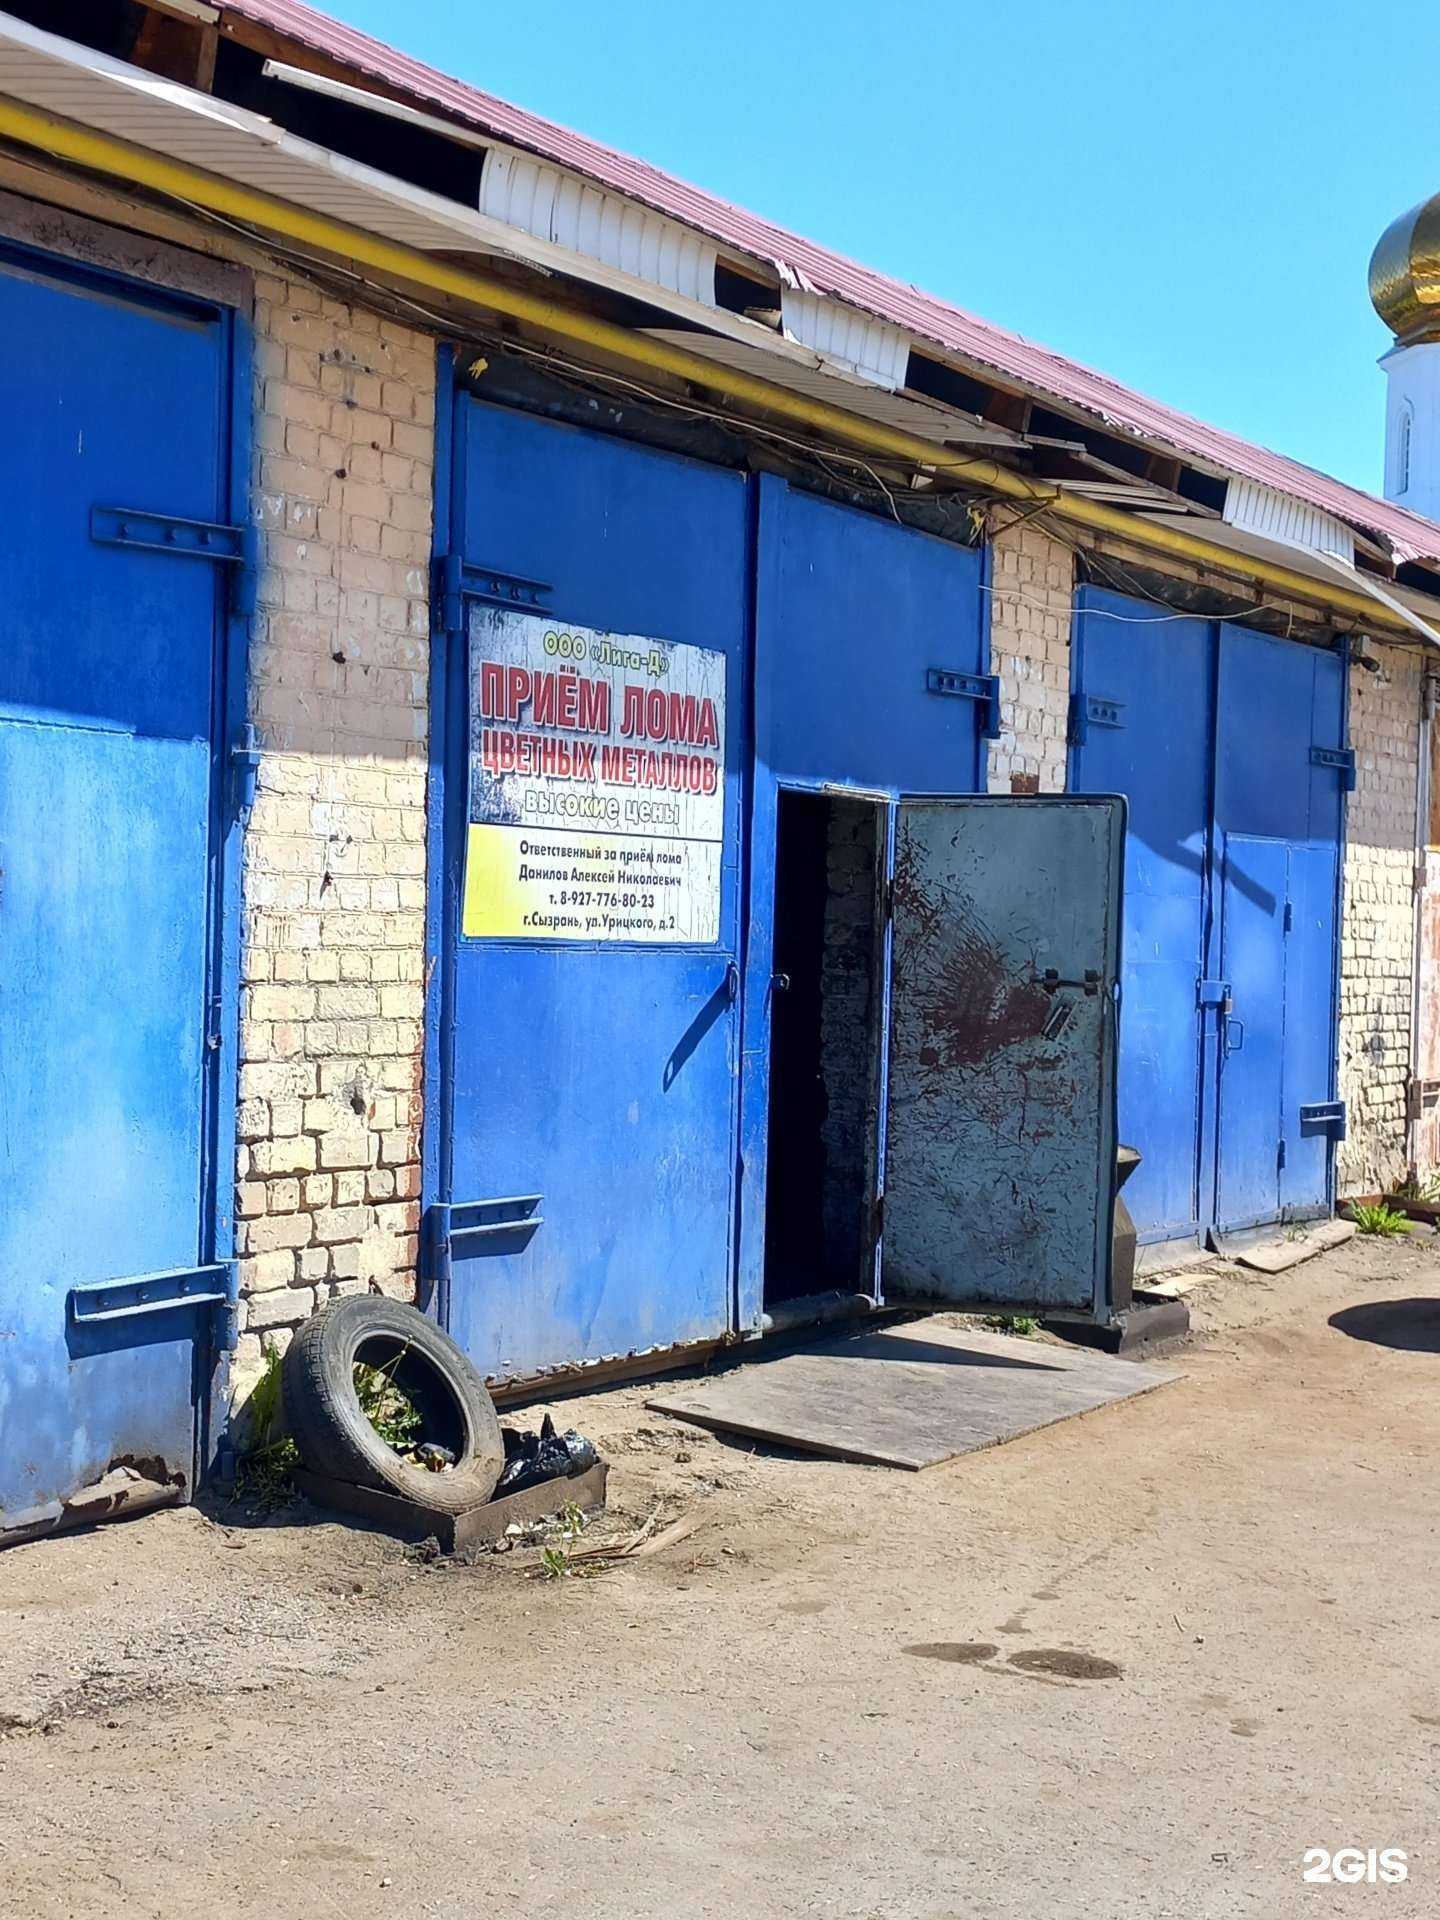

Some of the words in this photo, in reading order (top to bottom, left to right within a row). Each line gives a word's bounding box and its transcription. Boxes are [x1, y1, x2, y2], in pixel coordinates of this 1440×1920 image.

[543, 630, 587, 660] ООО
[591, 641, 670, 678] «Лига-Д»
[480, 661, 611, 733] ПРИЁМ
[620, 684, 719, 749] ЛОМА
[482, 728, 595, 782] ЦВЕТНЫХ
[601, 744, 717, 794] МЕТАЛЛОВ
[625, 800, 680, 825] цены
[519, 840, 602, 860] Ответственный
[604, 848, 617, 860] за
[656, 853, 682, 864] лома
[519, 864, 568, 882] Данилов
[571, 867, 615, 884] Алексей
[617, 870, 681, 887] Николаевич
[549, 894, 557, 905] т.
[560, 892, 655, 908] 8-927-776-80-23
[659, 916, 675, 930] д.2
